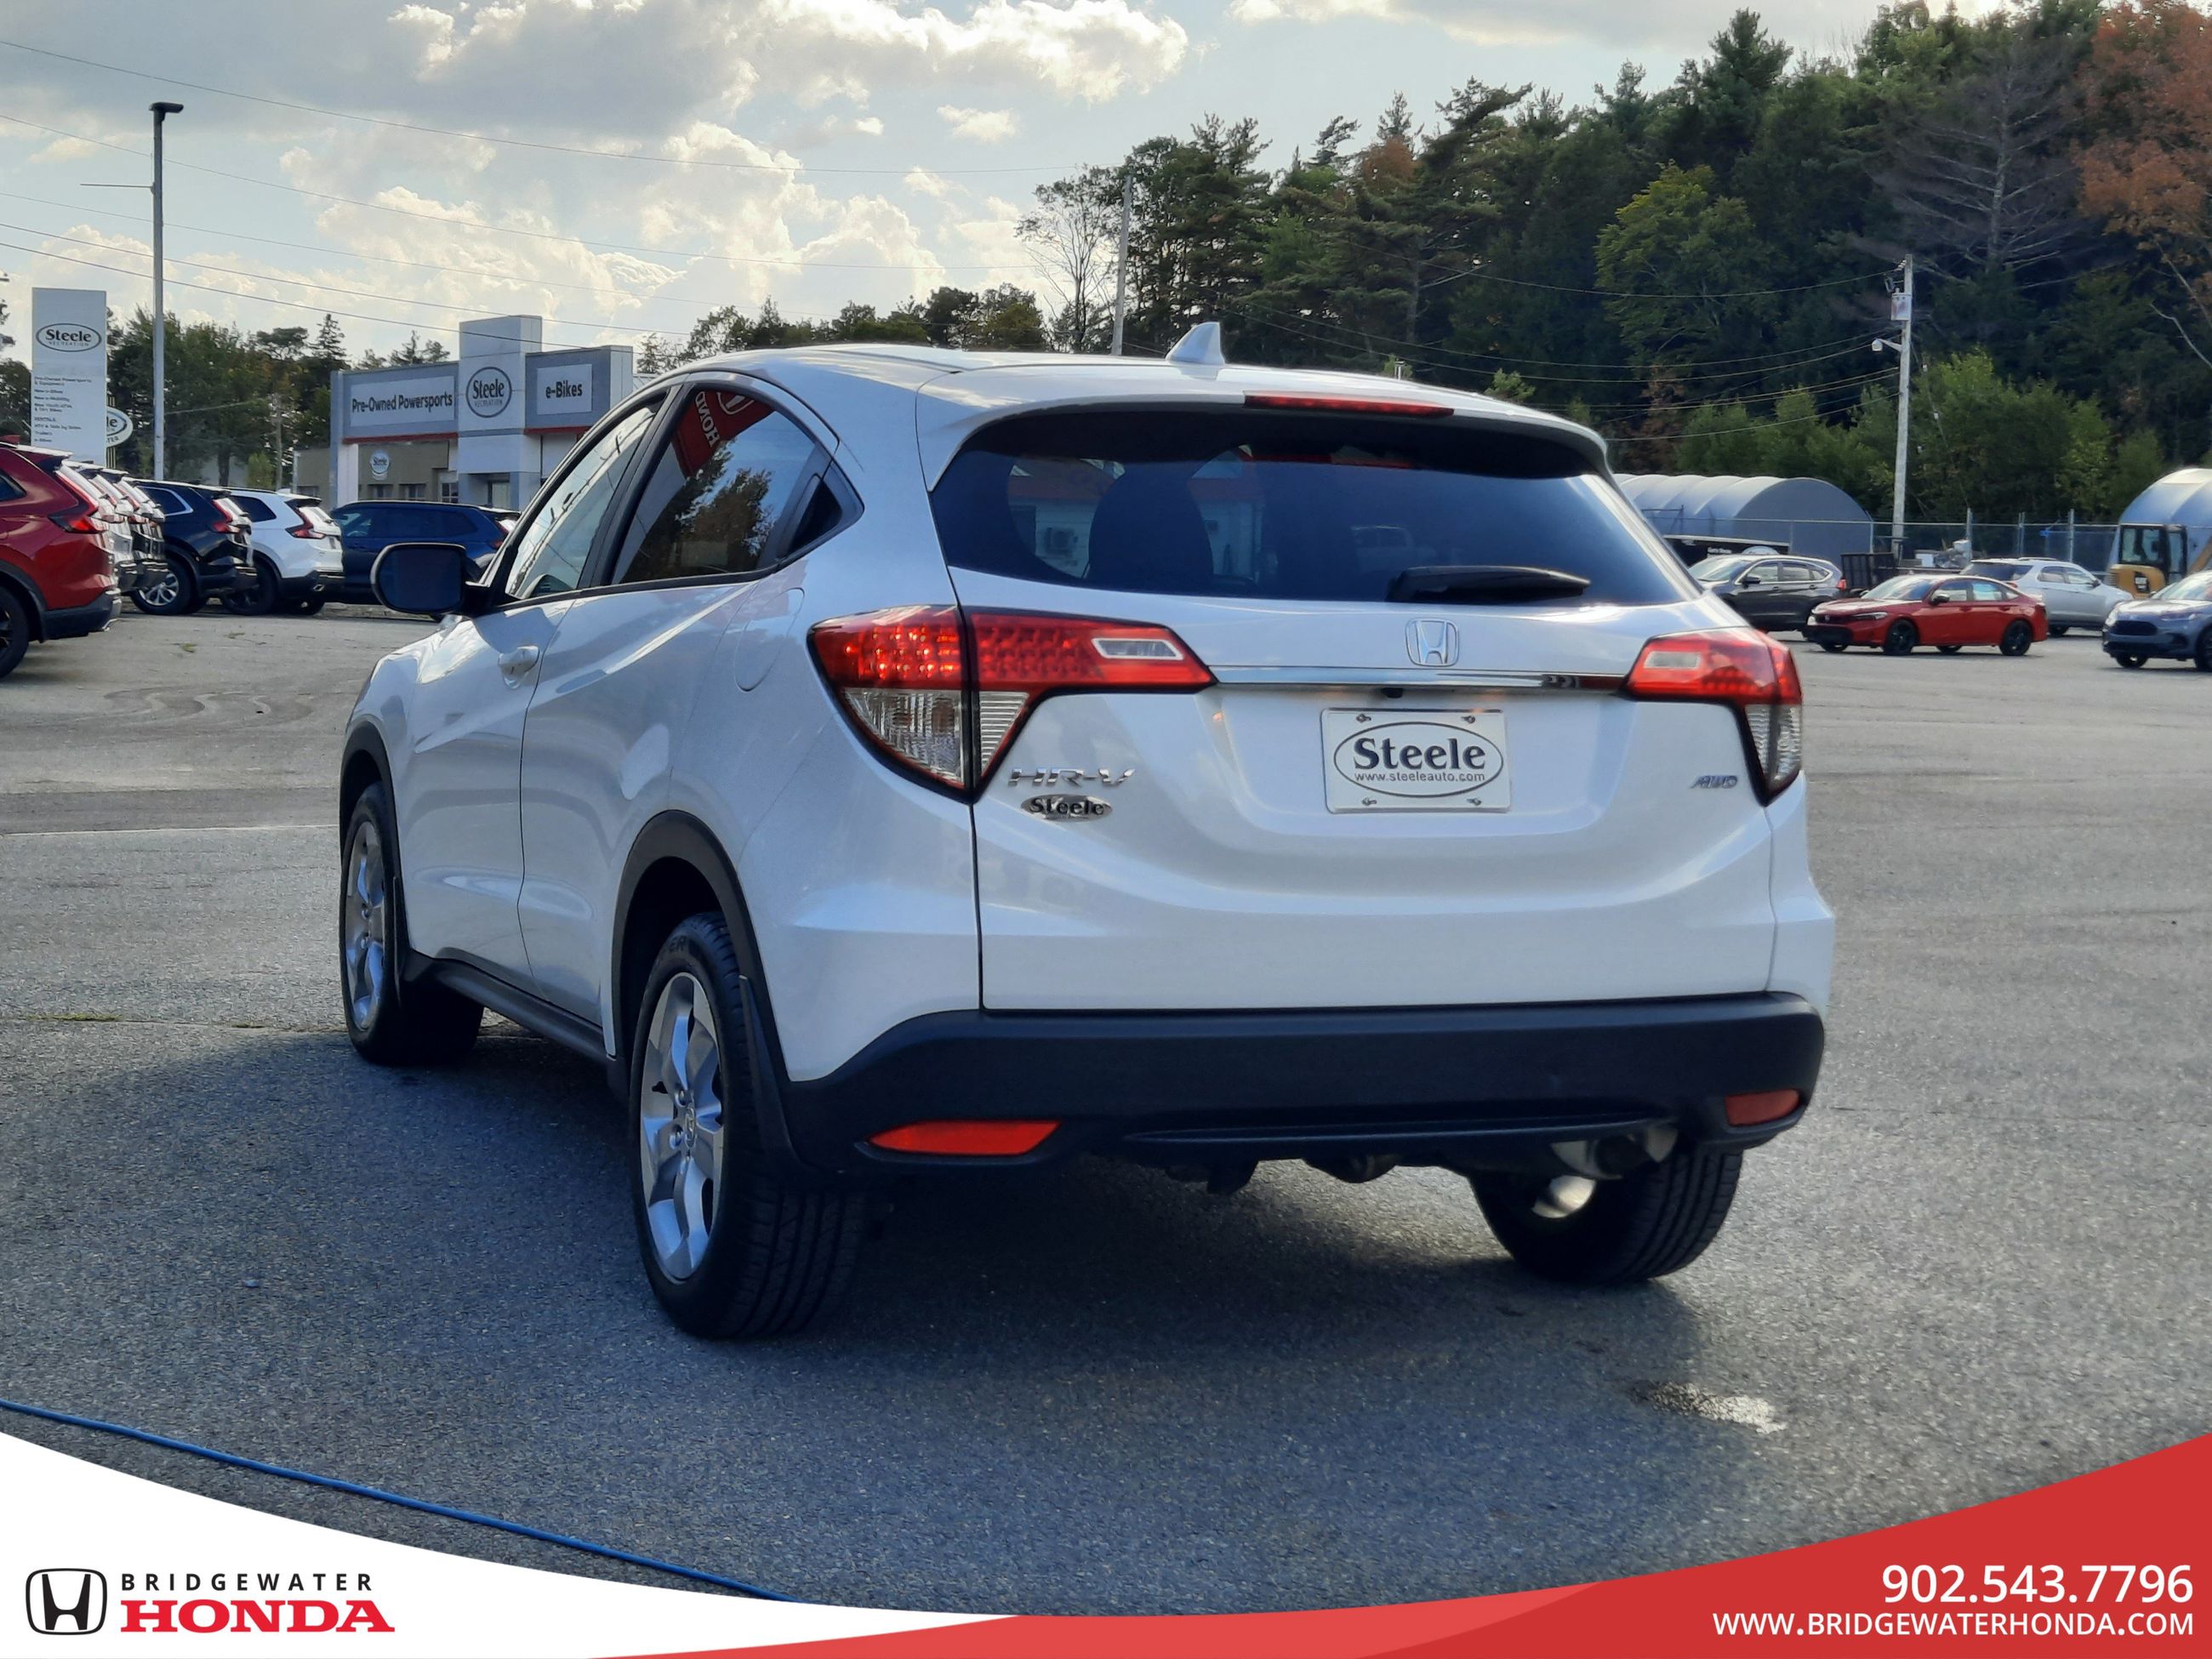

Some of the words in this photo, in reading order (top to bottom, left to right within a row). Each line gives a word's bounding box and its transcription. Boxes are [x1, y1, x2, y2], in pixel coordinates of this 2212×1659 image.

[45, 328, 92, 342] Steele
[472, 379, 505, 400] Steele
[545, 379, 583, 399] e-Bikes
[351, 395, 396, 413] Pre-Owned
[397, 391, 453, 413] Powersports
[1353, 737, 1486, 771] Steele
[1008, 768, 1136, 788] HR-V
[1354, 771, 1485, 782] www.steeleauto.com
[1029, 797, 1105, 816] Steele
